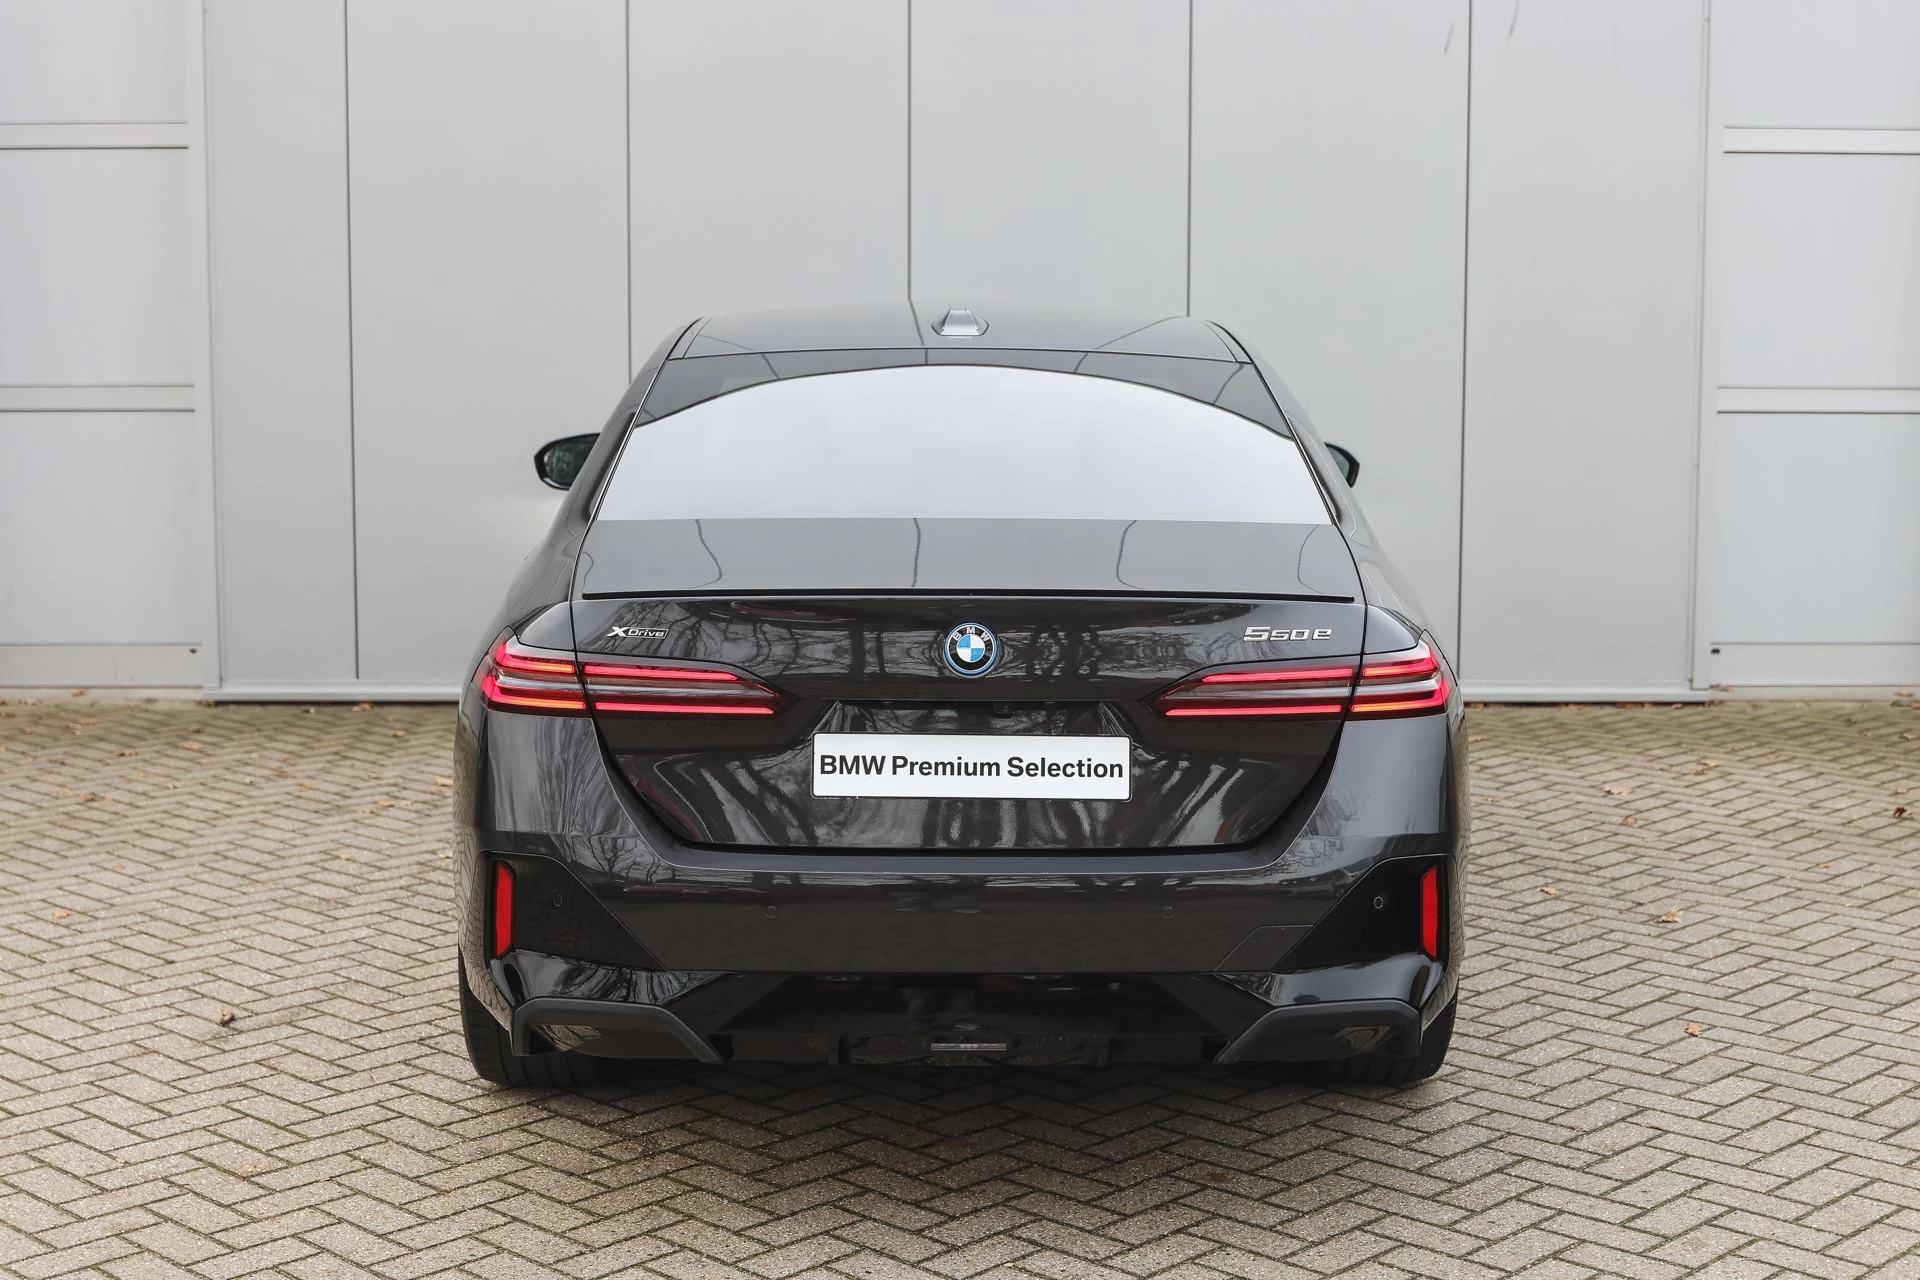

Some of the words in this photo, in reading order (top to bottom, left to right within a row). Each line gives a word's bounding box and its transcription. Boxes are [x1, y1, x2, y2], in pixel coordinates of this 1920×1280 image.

[952, 626, 991, 642] BMW
[820, 754, 886, 775] BMW
[892, 755, 1000, 776] Premium
[1007, 756, 1123, 778] Selection
